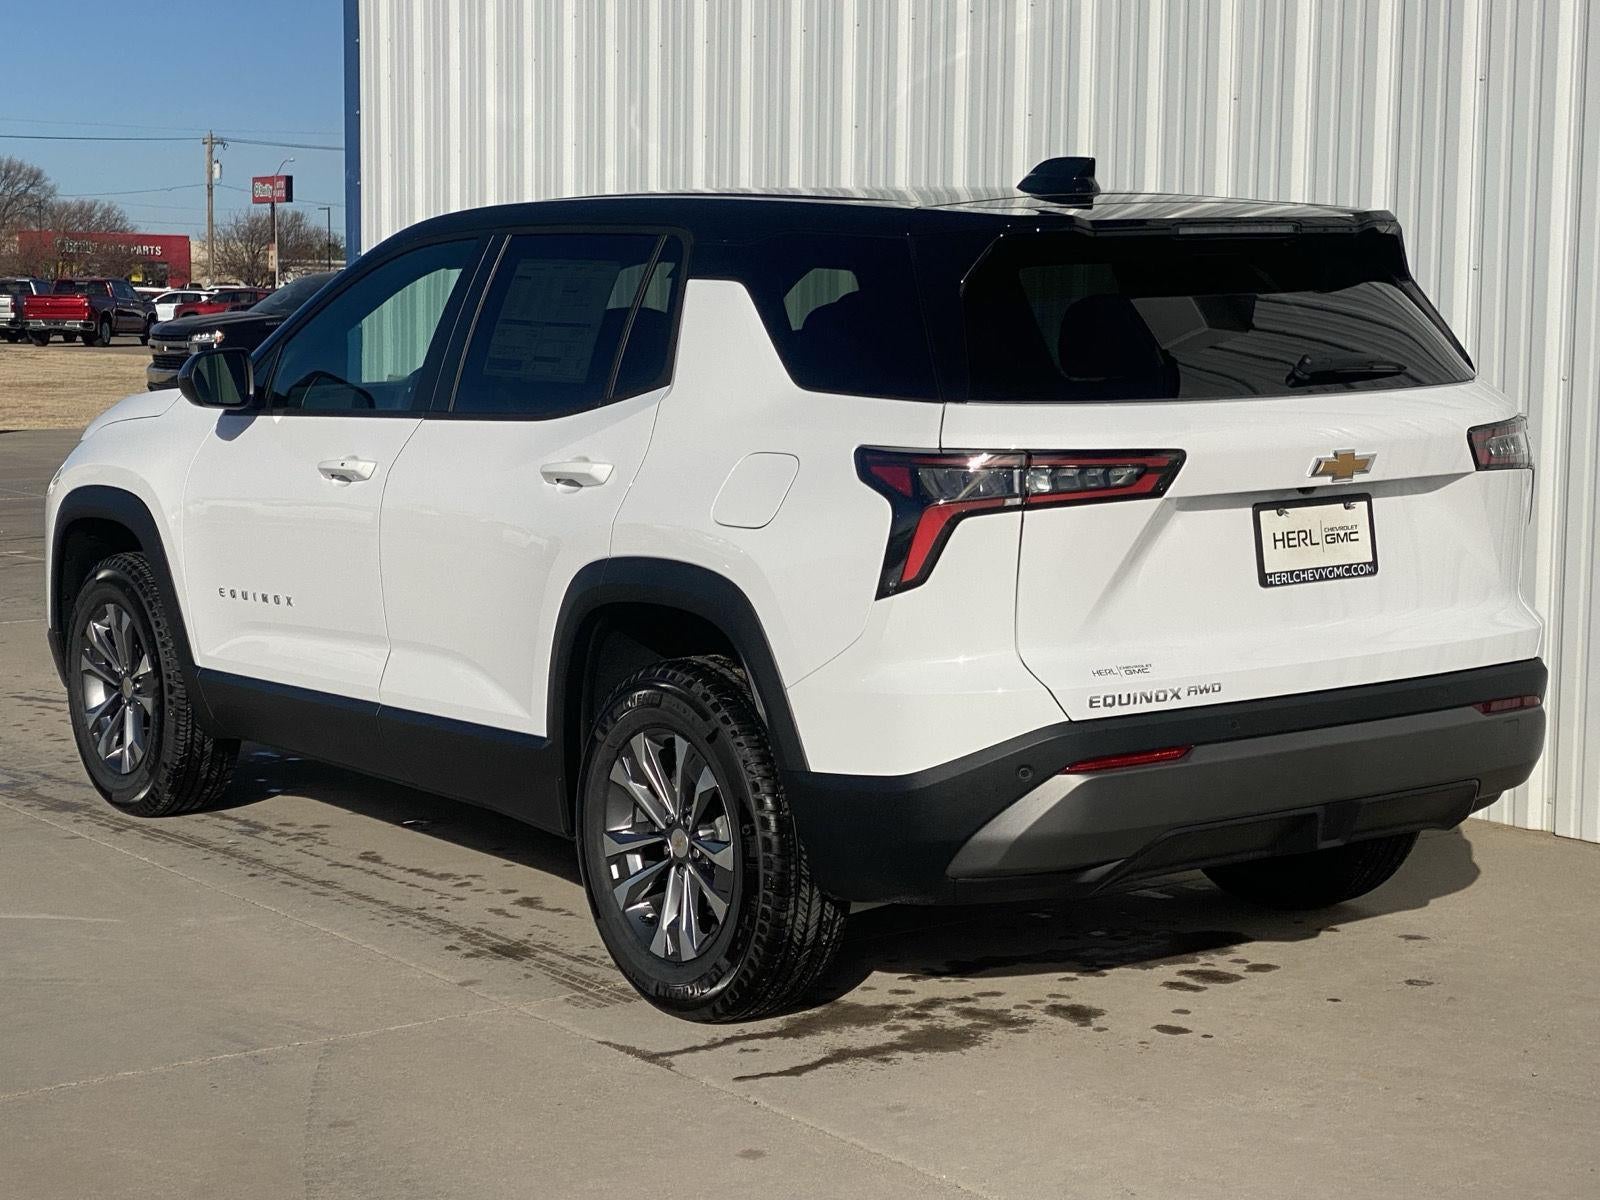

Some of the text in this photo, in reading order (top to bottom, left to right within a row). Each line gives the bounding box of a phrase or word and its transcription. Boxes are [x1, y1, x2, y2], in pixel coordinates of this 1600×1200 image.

[131, 245, 162, 256] PARTS
[1323, 524, 1358, 533] CHEVROLET
[1272, 528, 1359, 550] HERL GMC
[1266, 563, 1375, 585] HERLCHEVYGMC.COM
[218, 587, 293, 607] EQUINOX
[1091, 667, 1150, 677] HERL GMC
[1088, 682, 1222, 709] EQUINOX AWD
